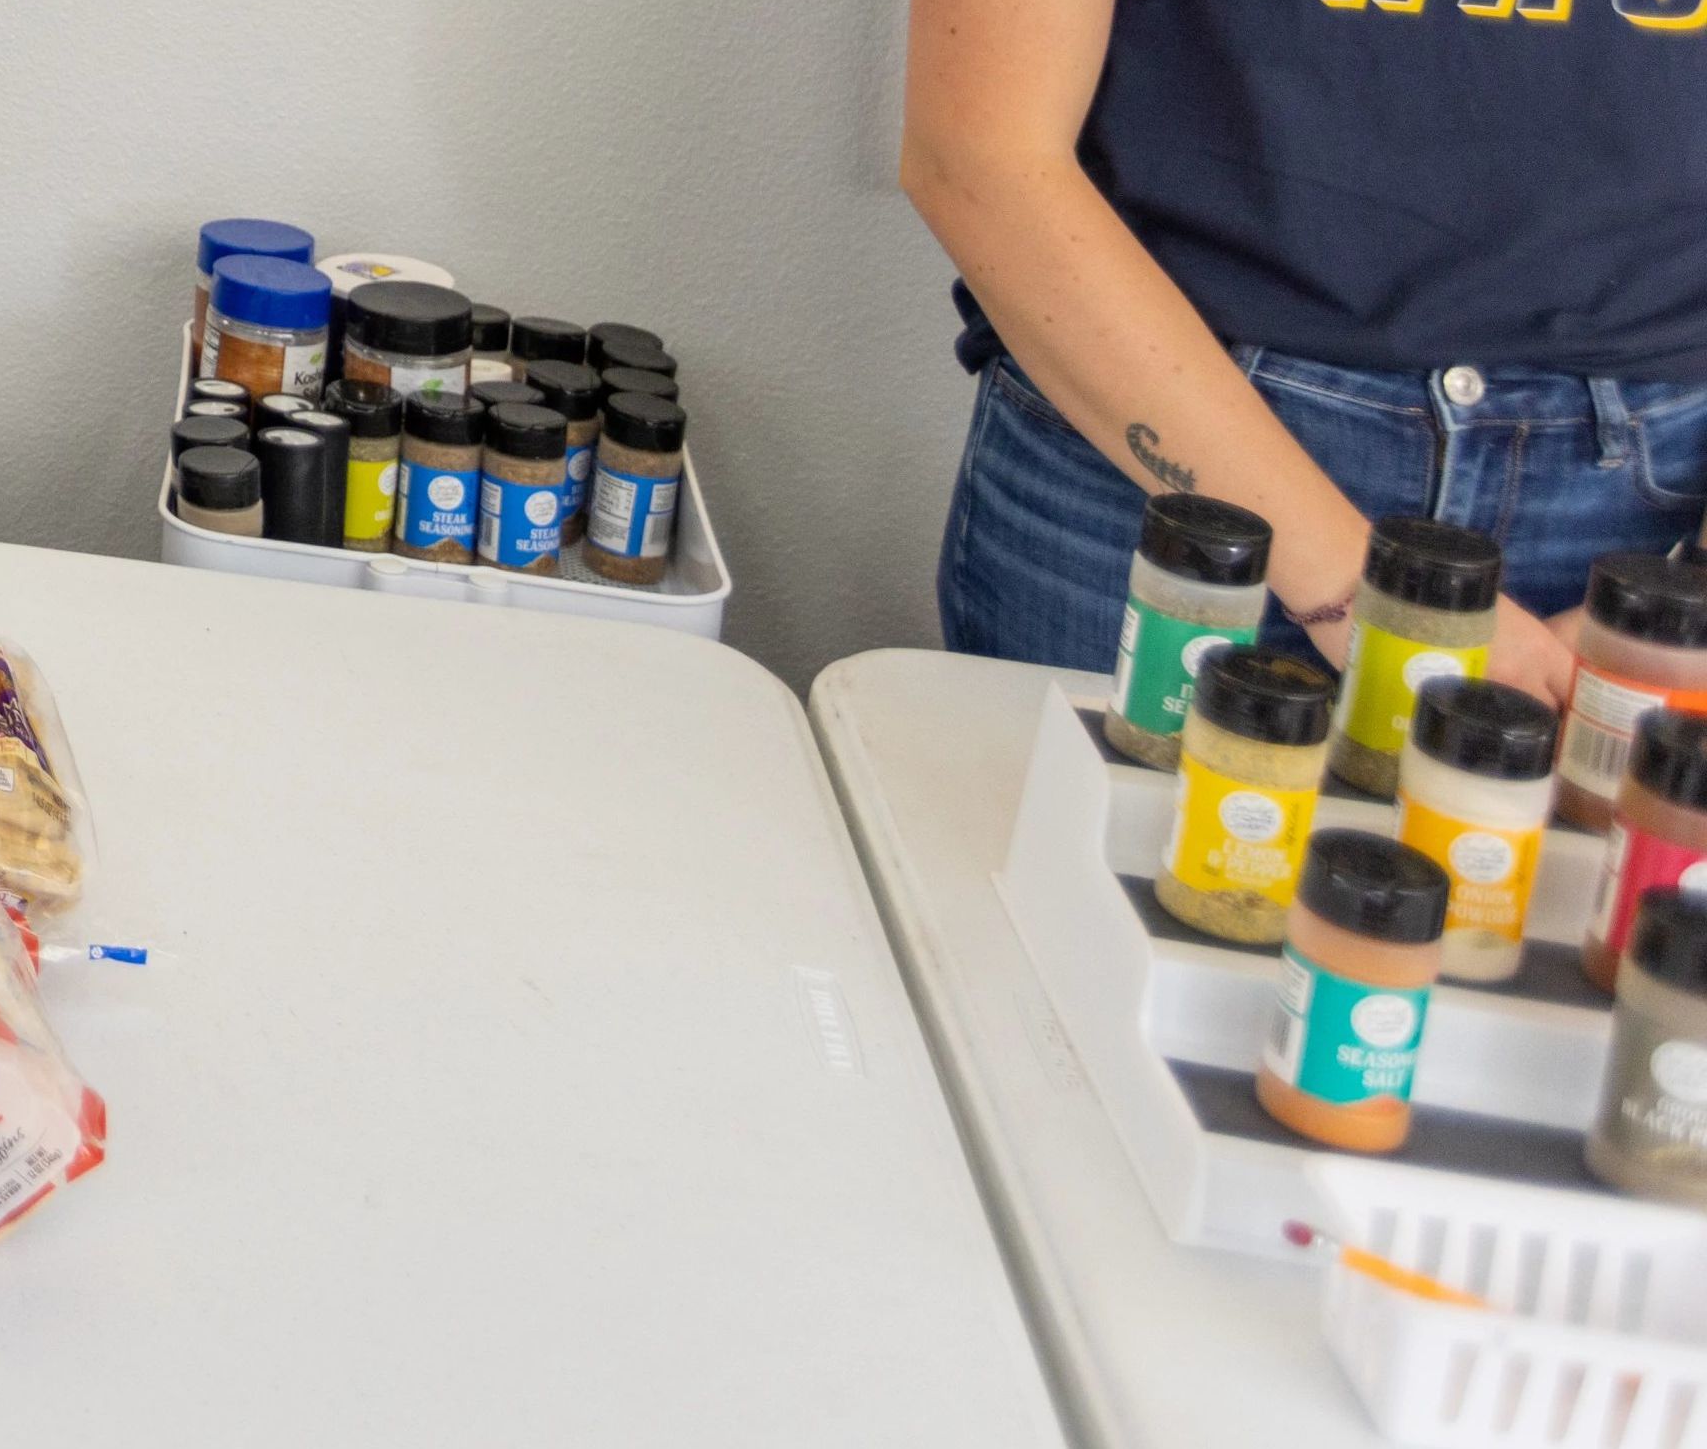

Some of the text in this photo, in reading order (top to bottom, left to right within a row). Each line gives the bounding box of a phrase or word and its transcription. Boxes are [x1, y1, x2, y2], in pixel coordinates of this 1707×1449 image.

[432, 511, 467, 524] STEAK
[515, 539, 560, 551] SEASON
[1360, 1069, 1405, 1089] SALT
